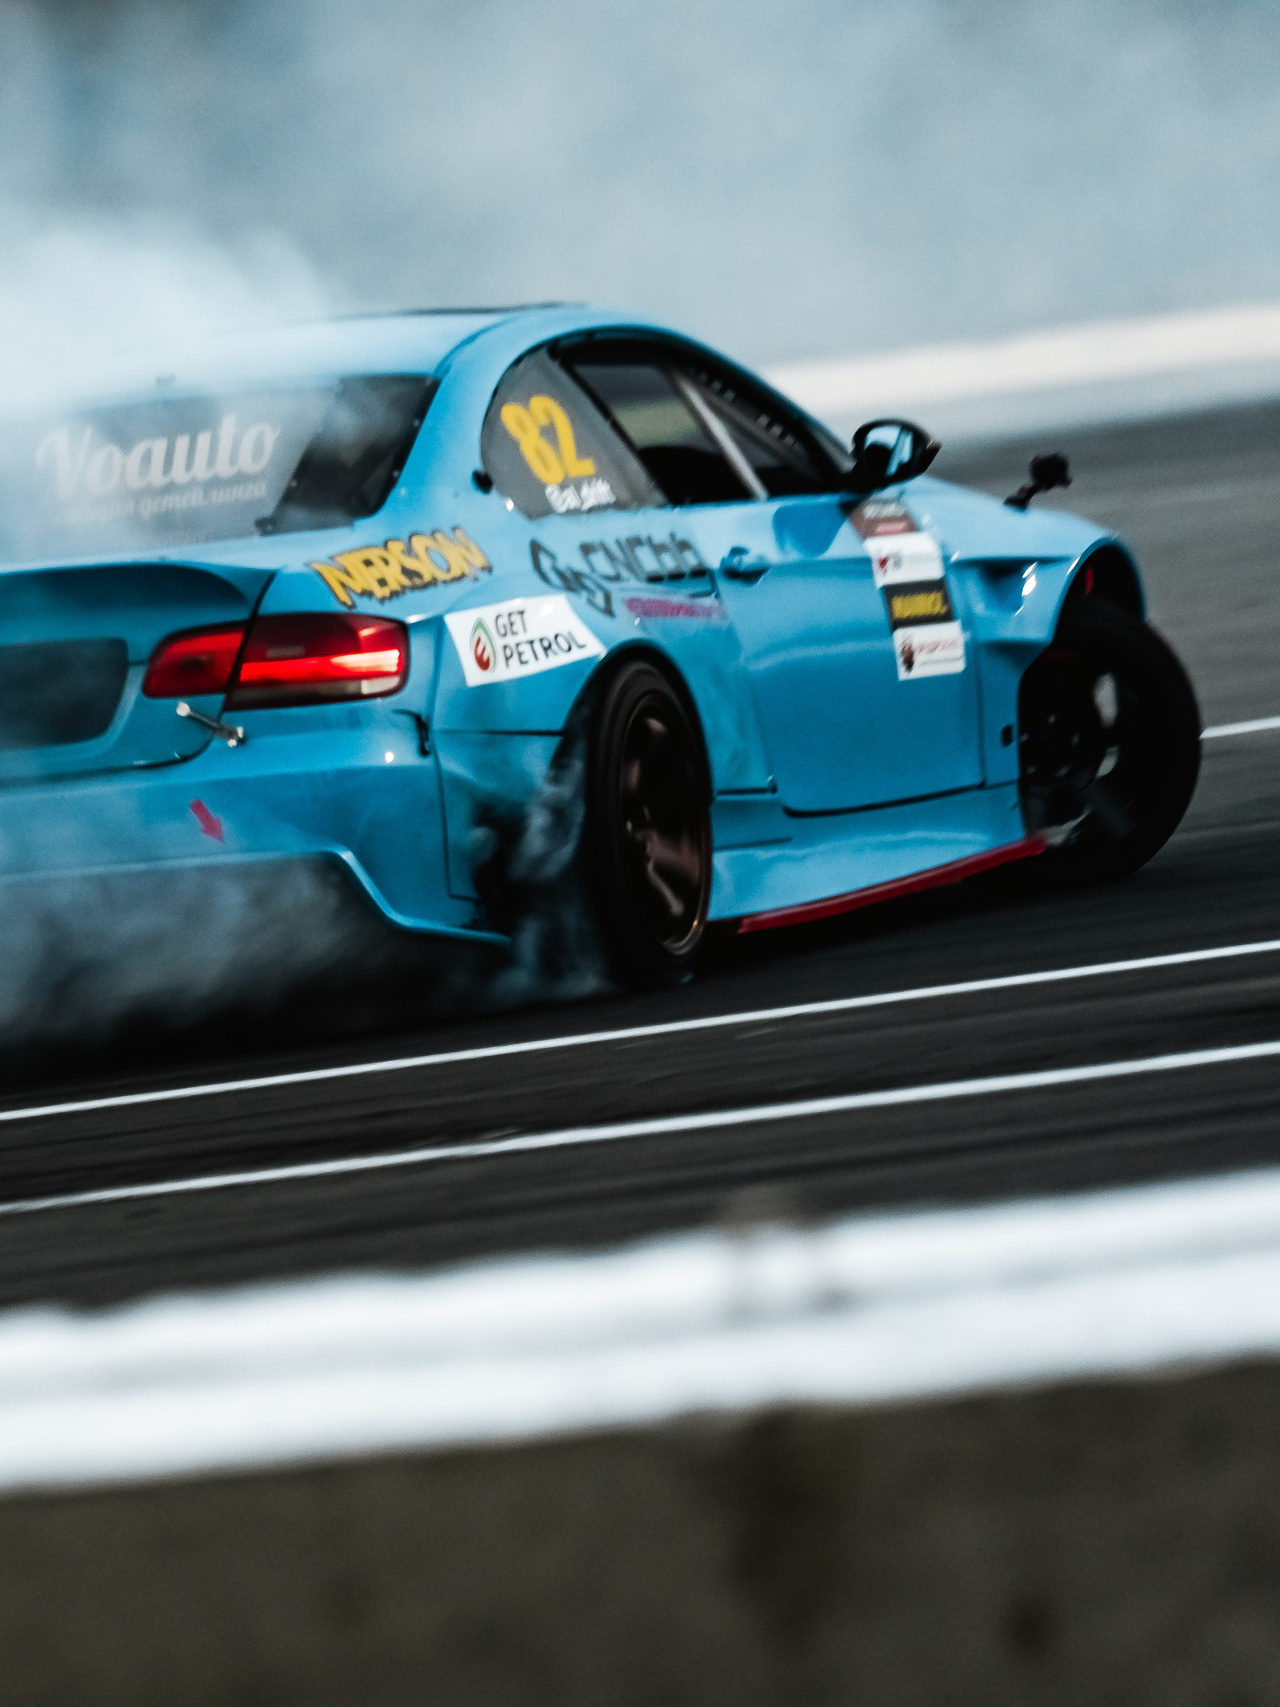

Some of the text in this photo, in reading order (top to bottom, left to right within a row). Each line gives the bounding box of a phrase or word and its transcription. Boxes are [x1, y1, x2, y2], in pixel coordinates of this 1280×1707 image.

[500, 395, 595, 486] 82
[494, 609, 528, 639] GET
[502, 630, 587, 669] PETROL
